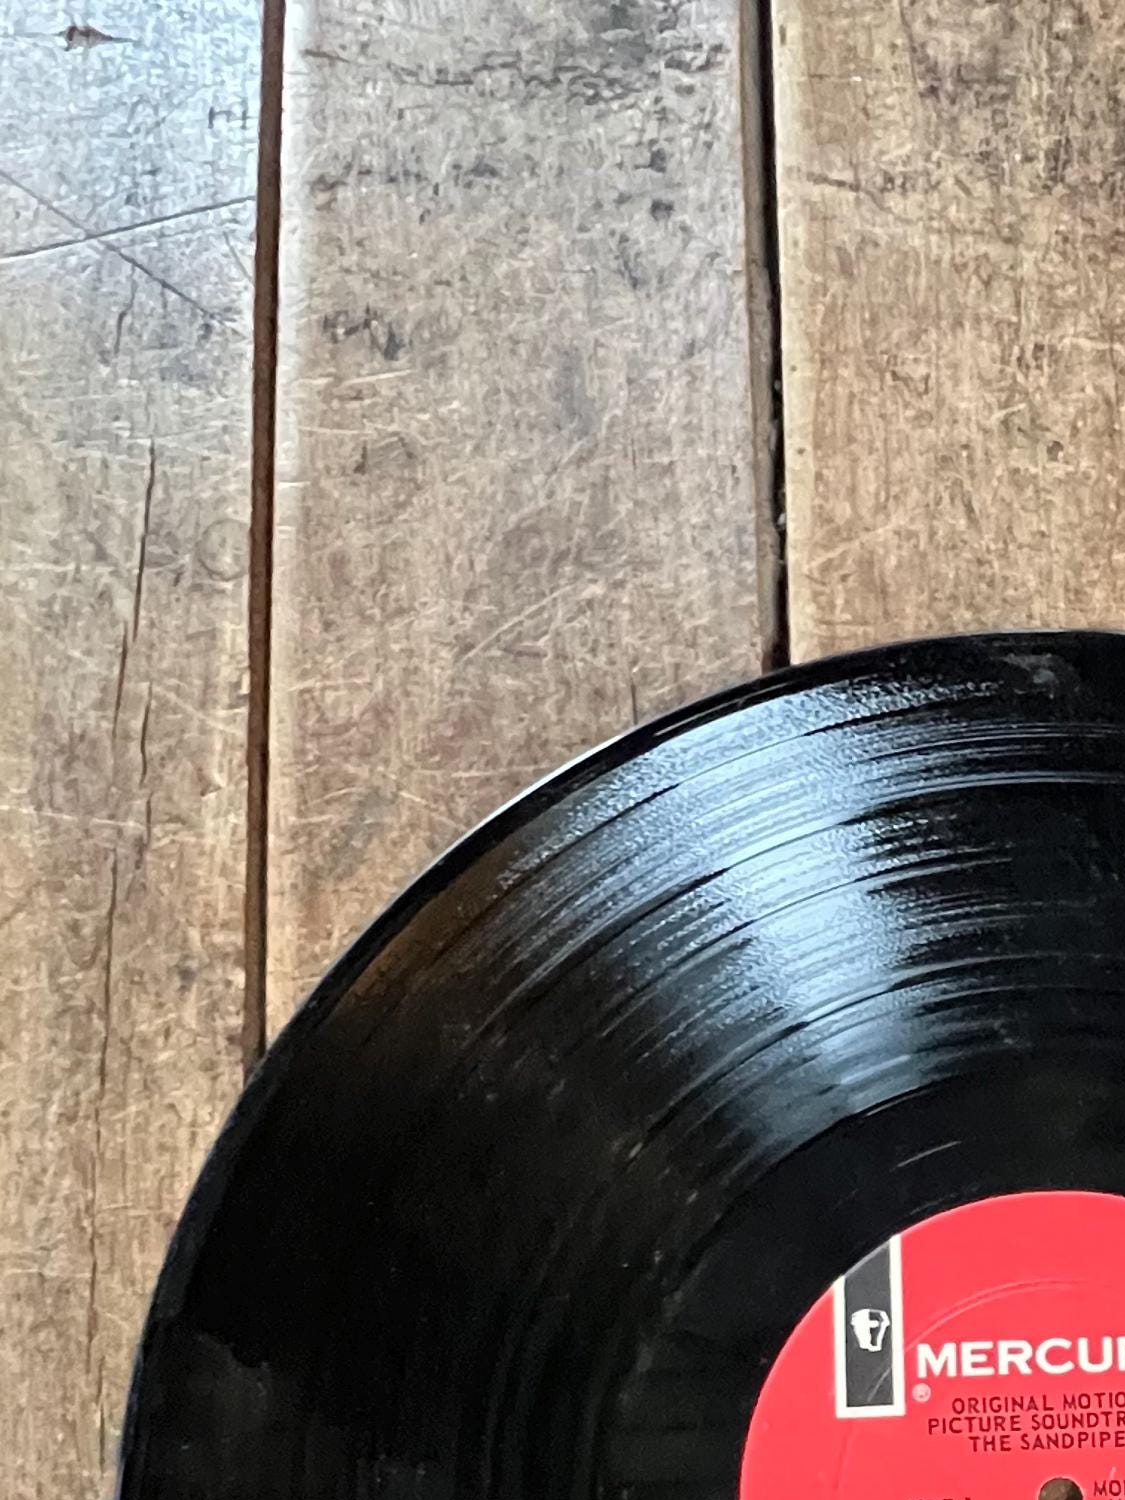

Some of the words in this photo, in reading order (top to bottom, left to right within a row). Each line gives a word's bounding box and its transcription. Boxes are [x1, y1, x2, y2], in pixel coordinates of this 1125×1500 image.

[952, 1395, 1054, 1415] ORIGINAL
[928, 1415, 1021, 1435] PICTURE
[969, 1435, 1011, 1452] THE
